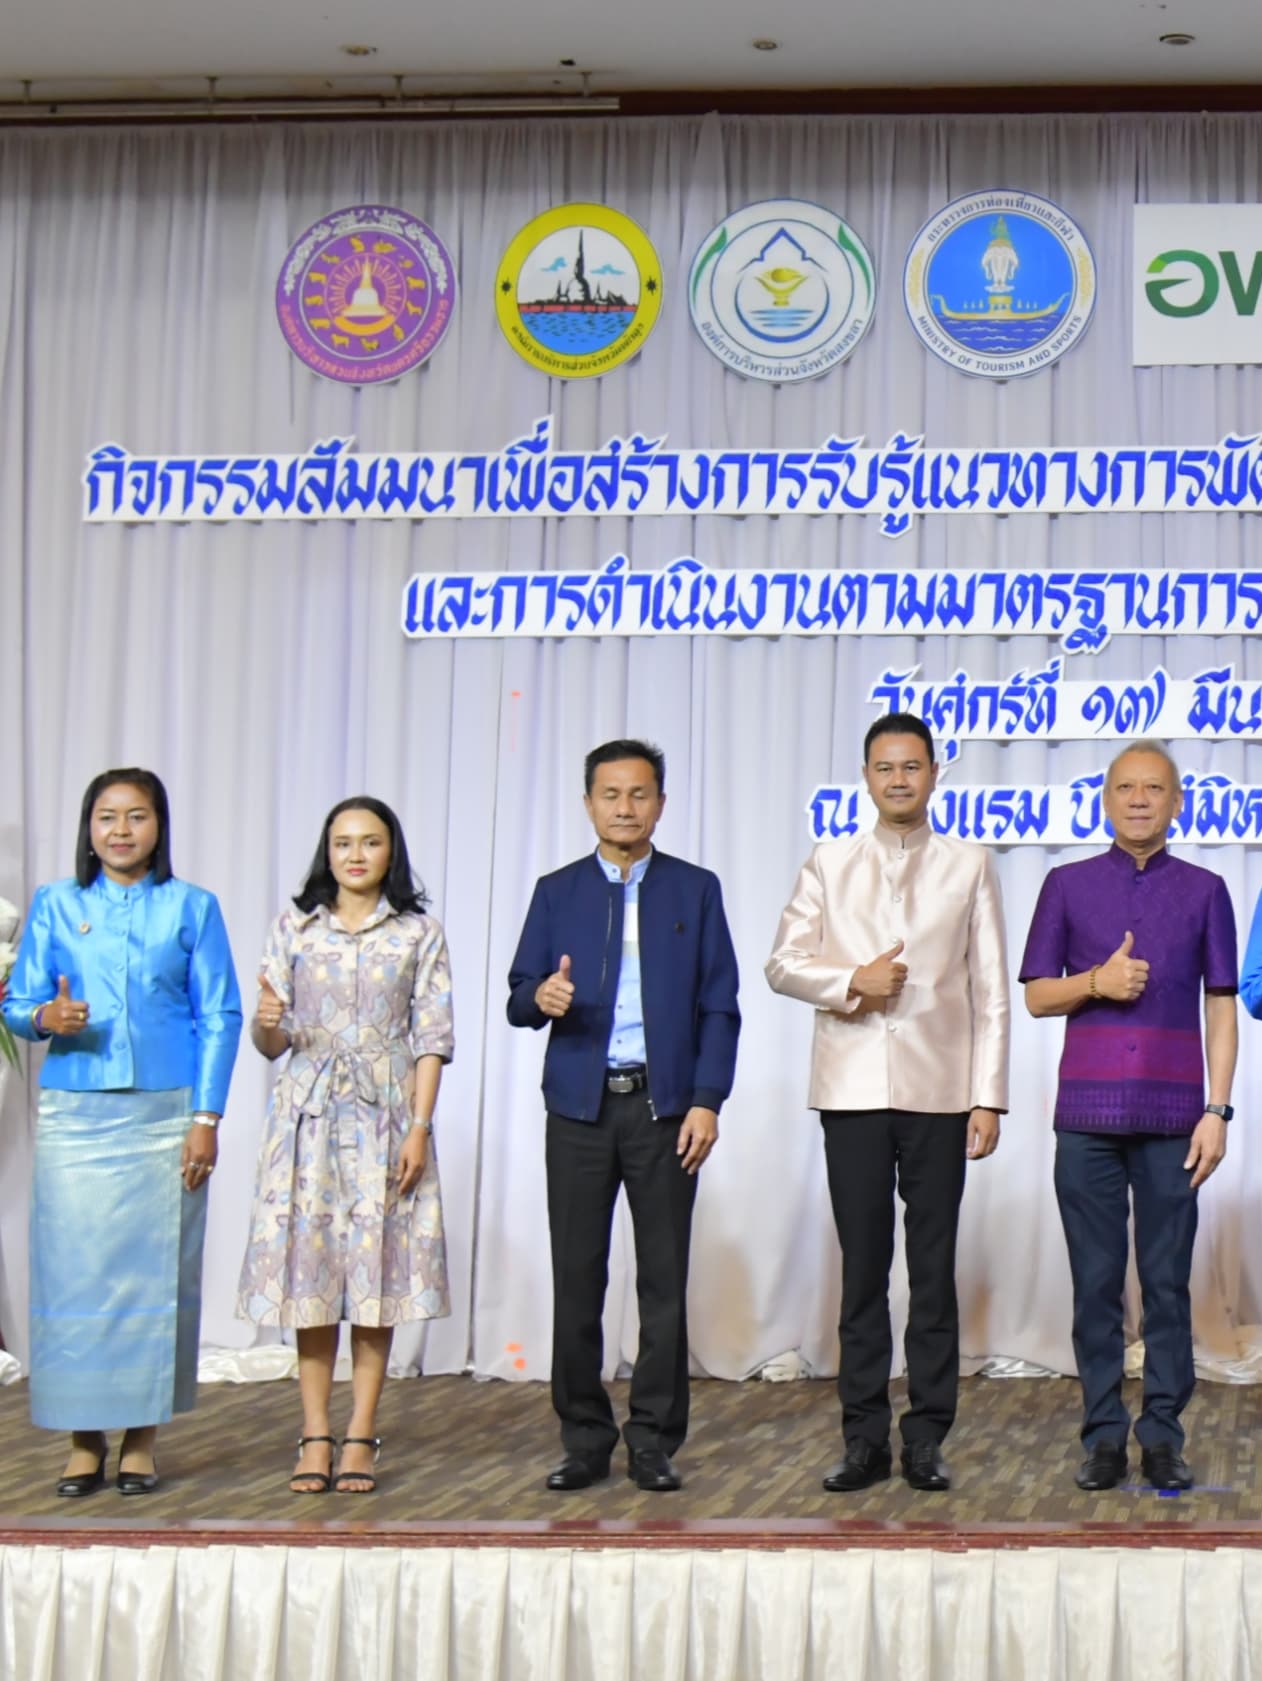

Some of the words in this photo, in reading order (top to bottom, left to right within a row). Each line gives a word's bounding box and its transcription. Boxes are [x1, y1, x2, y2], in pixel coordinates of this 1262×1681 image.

[917, 315, 956, 359] MINISTRY
[957, 353, 972, 367] OF
[975, 359, 1026, 373] TOURISM
[1028, 346, 1052, 368] AND
[1050, 314, 1083, 350] SPORTS
[1081, 671, 1166, 735] ๑๗
[810, 788, 859, 839] ณ
